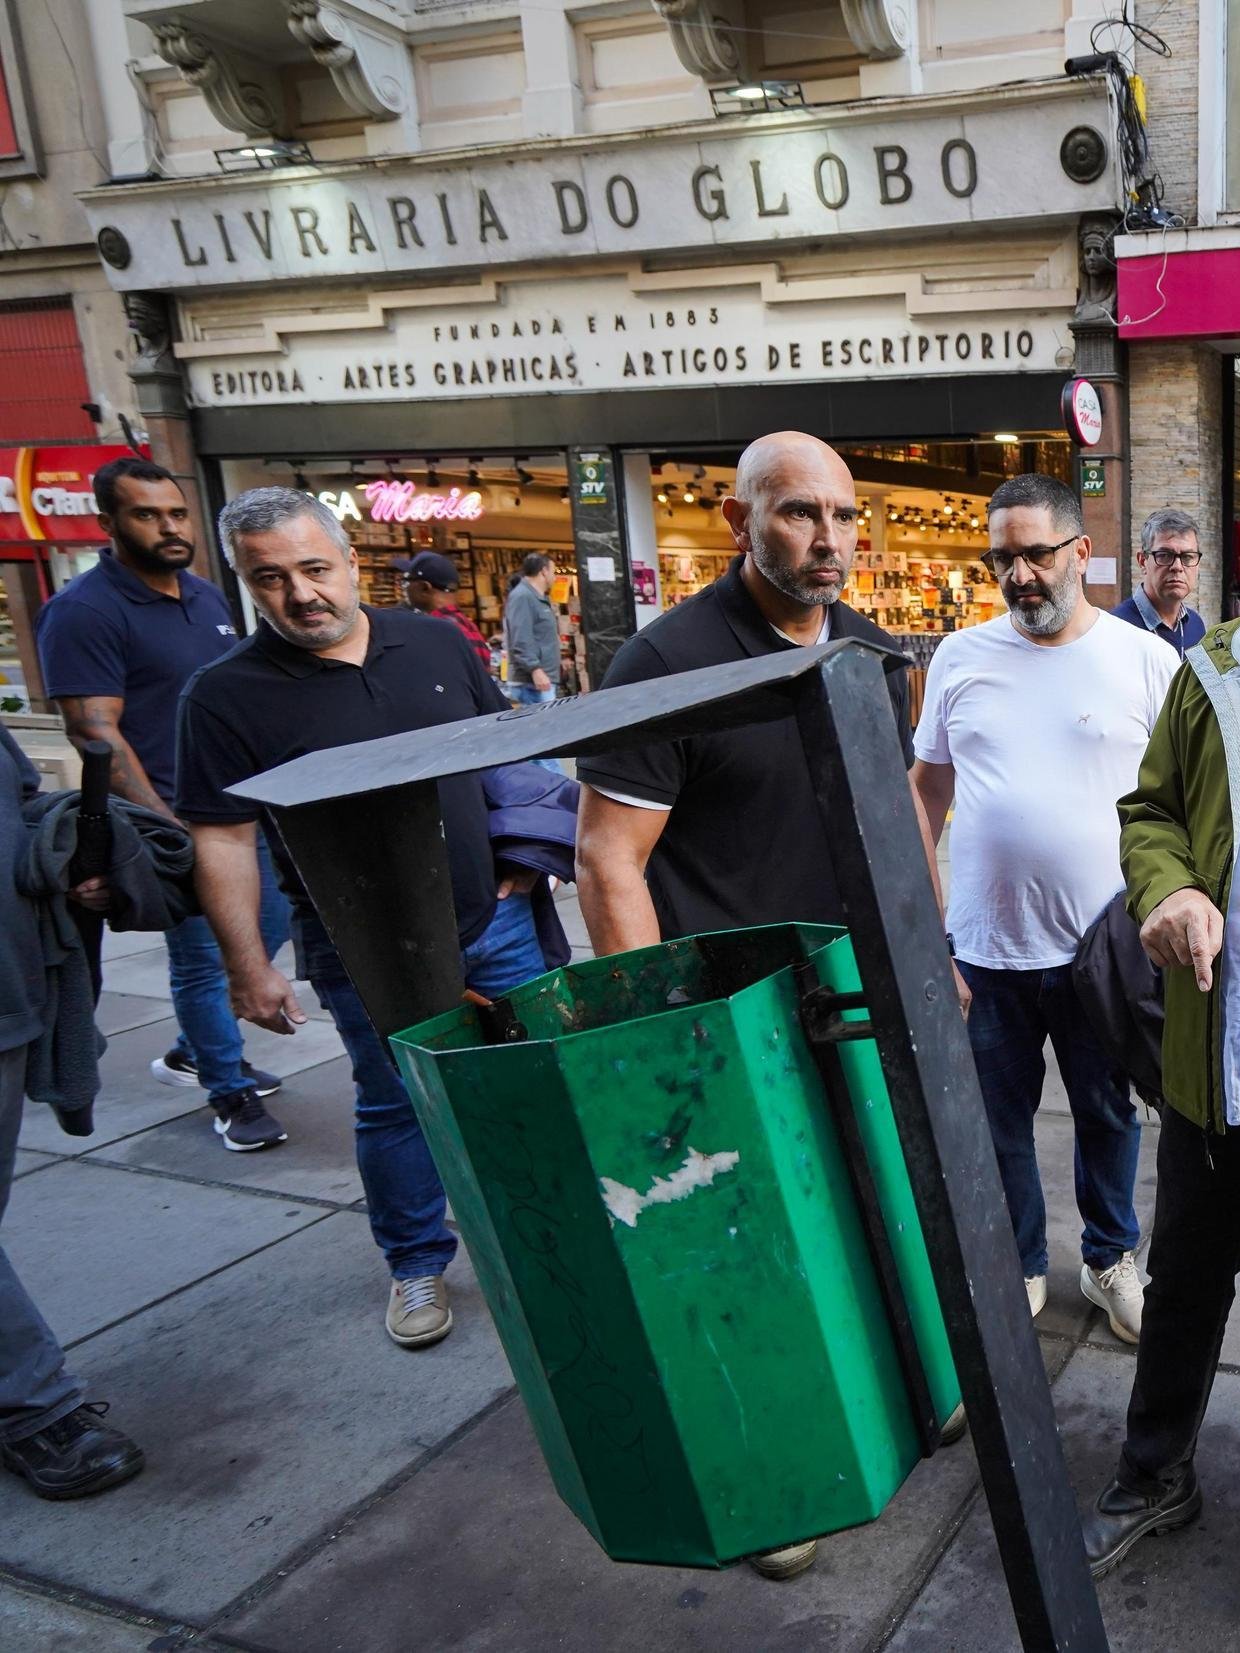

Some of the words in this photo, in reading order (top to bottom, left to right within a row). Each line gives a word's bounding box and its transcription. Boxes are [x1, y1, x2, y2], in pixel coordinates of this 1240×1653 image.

[171, 189, 508, 266] LIVRARIA
[552, 174, 639, 235] DO
[692, 138, 977, 222] GLOBO
[434, 317, 562, 342] FUNDADA
[588, 314, 626, 334] EM
[649, 308, 719, 329] 1883
[623, 345, 747, 378] ARTIGOS
[768, 343, 801, 371] DE
[822, 330, 1033, 367] ESCRIPTORIO
[211, 368, 305, 396] EDITORA
[344, 364, 416, 389] ARTES
[434, 354, 577, 386] GRAPHICAS
[315, 491, 363, 521] SA
[365, 481, 484, 522] Maria
[580, 482, 604, 494] STV
[1083, 481, 1104, 490] STV
